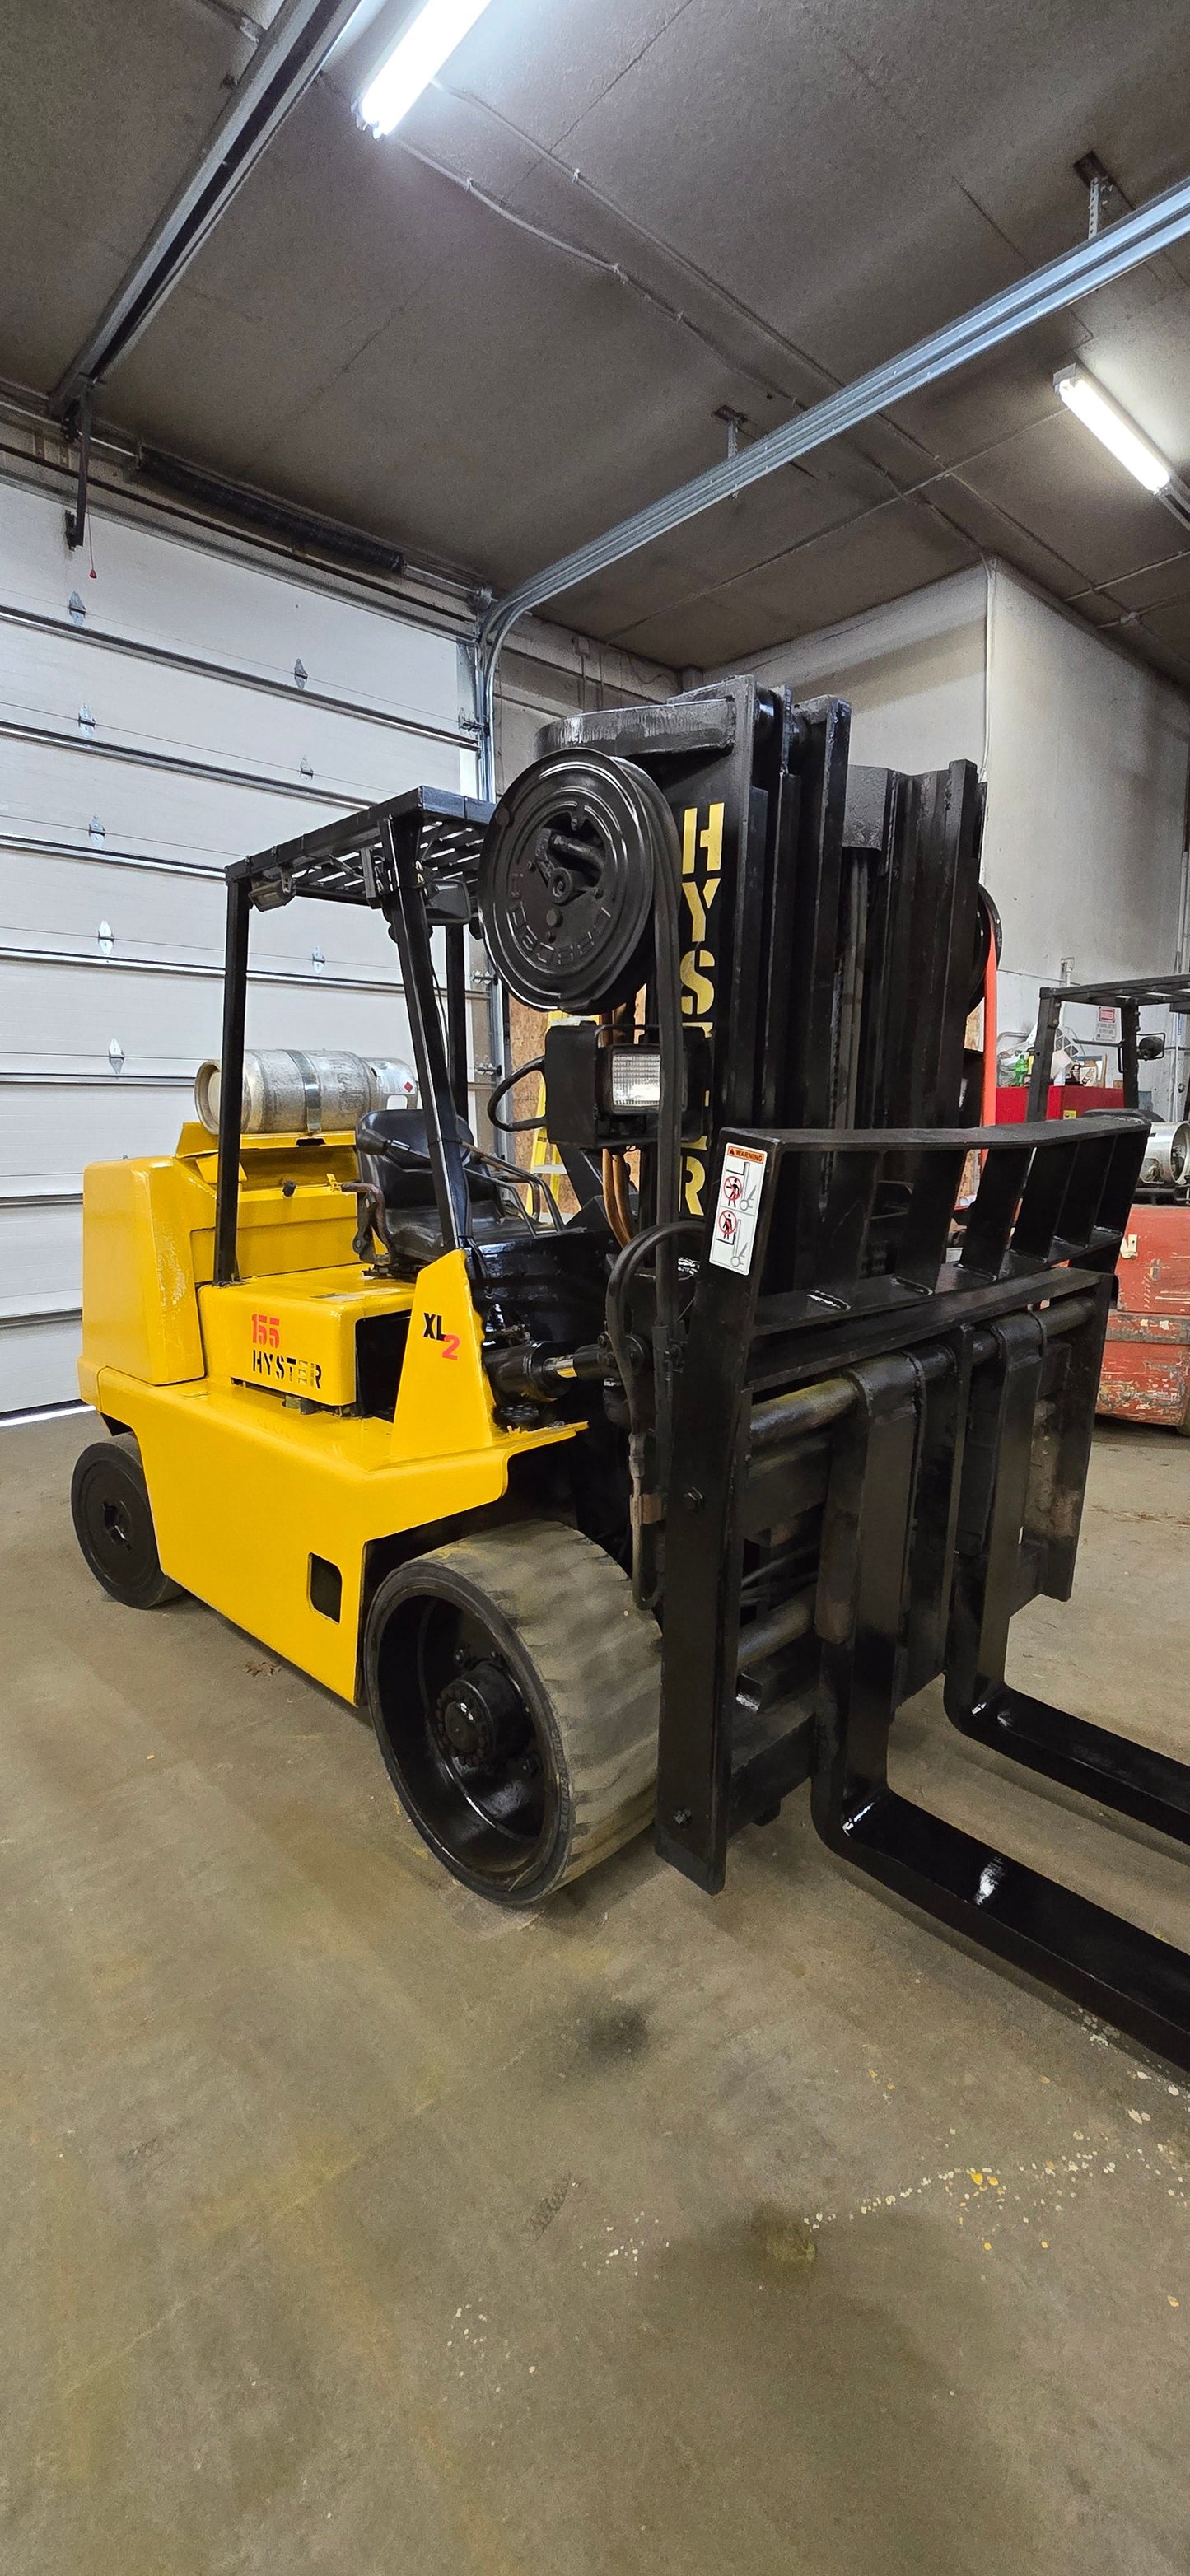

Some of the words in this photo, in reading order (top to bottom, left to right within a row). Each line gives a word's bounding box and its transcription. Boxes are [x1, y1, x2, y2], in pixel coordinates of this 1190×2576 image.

[679, 802, 725, 1216] HYSR
[735, 1149, 763, 1162] WARNING
[252, 1313, 280, 1348] 155
[253, 1349, 322, 1389] HYSTER
